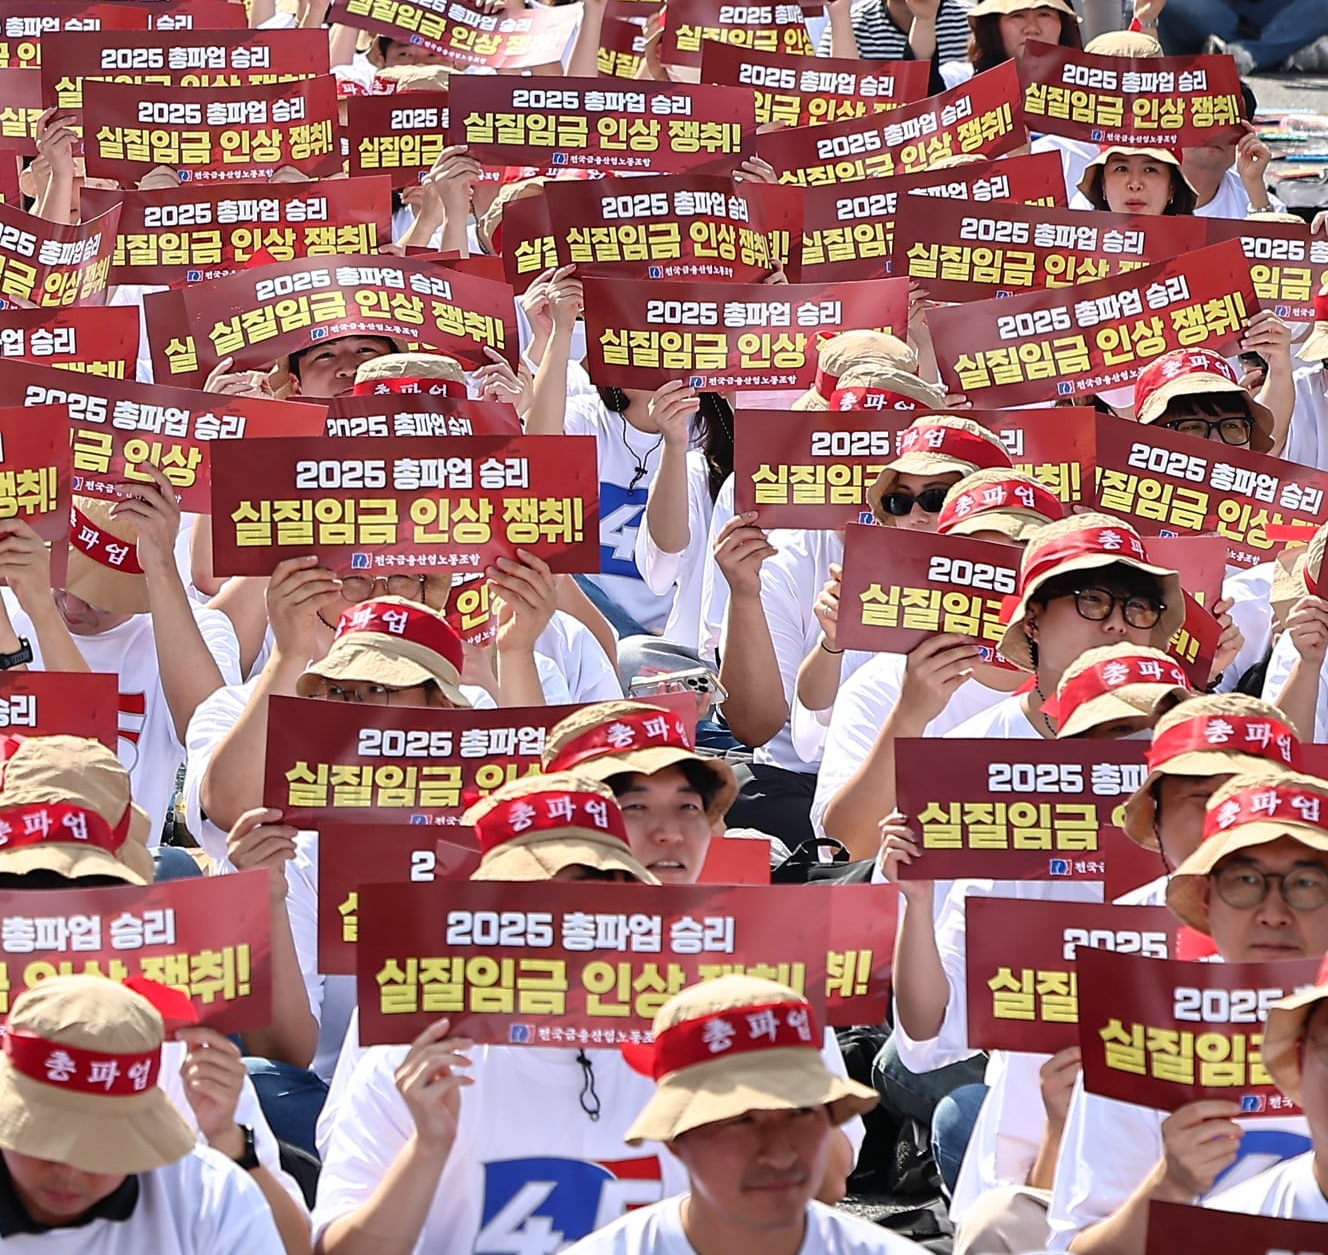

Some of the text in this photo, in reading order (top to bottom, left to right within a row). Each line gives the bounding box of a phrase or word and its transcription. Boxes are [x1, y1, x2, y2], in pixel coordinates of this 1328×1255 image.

[1062, 63, 1206, 93] 2025 총파업 승리
[1024, 81, 1240, 128] 실질임금 인상 쟁취!
[997, 274, 1189, 339] 2025 총파업 승리
[953, 295, 1254, 390] 실질임금 인상 쟁취!
[296, 457, 528, 490] 2025 총파업 승리
[230, 496, 583, 546] 실질임금 인상 쟁취!
[955, 485, 1034, 517] 총파업
[509, 805, 609, 832] 총파업
[1216, 791, 1320, 828] 총파업
[703, 1008, 813, 1053] 총파업
[46, 1051, 152, 1092] 총파업
